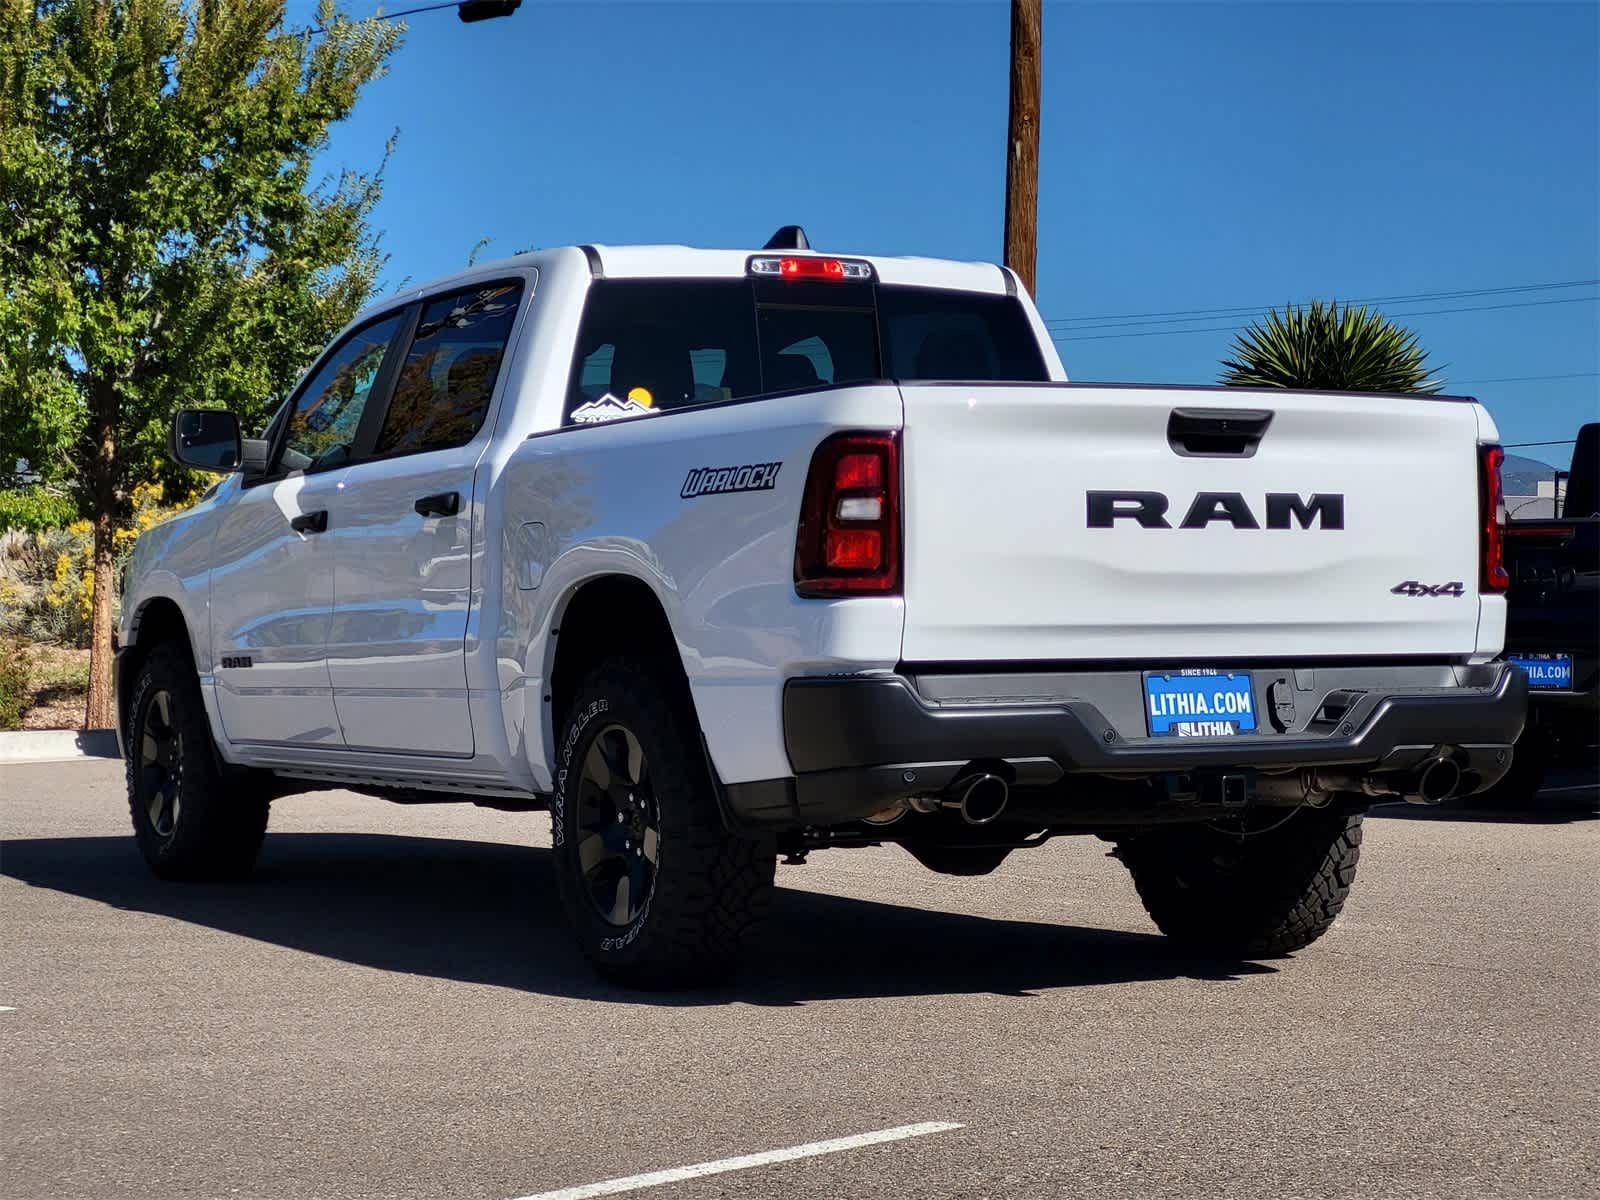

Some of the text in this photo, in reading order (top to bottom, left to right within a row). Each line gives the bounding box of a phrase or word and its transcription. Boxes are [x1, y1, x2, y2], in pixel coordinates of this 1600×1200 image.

[680, 462, 783, 499] WARLOCK
[1086, 490, 1345, 530] RAM
[1389, 580, 1466, 598] 4x4
[221, 656, 253, 668] RAM
[1180, 668, 1201, 676] SINCE
[1150, 692, 1251, 716] LITHIA.COM
[1190, 721, 1234, 736] LITHIA
[555, 699, 609, 847] WRANGLER
